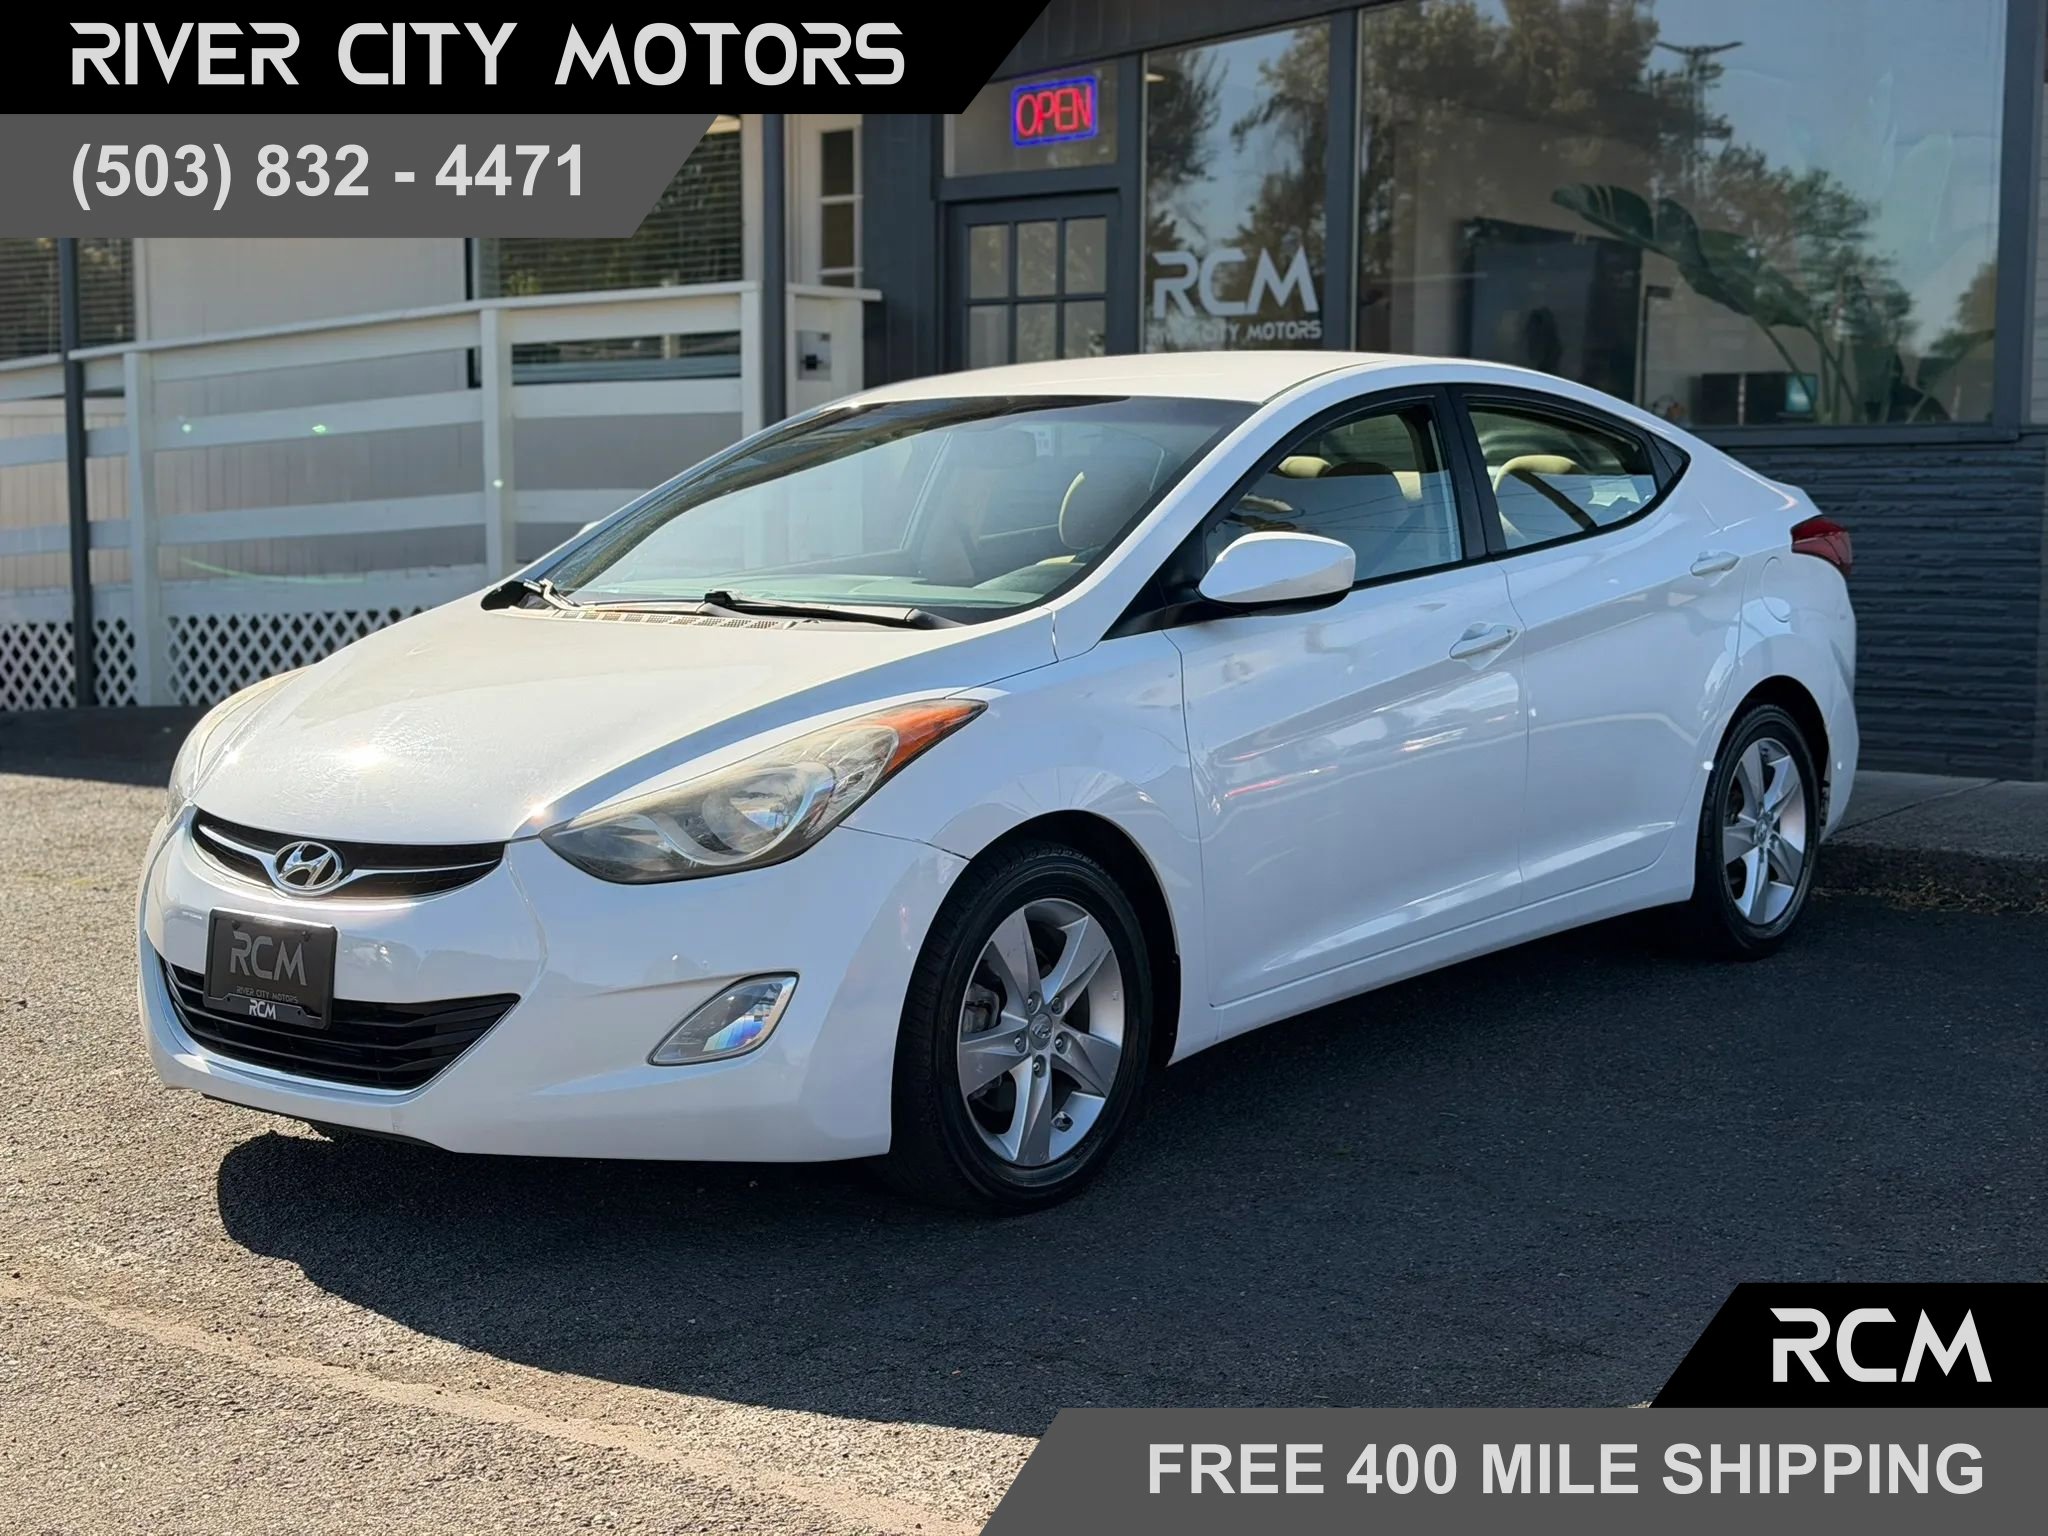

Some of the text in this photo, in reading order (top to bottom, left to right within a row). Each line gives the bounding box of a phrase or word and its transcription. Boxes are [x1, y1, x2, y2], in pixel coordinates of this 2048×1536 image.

[1016, 85, 1092, 138] OPEN
[1152, 245, 1320, 320] RCM
[1246, 319, 1323, 341] MOTORS
[229, 930, 308, 987] RCM
[236, 985, 254, 996] RIVER
[255, 988, 270, 999] CITY
[248, 998, 277, 1020] RCM
